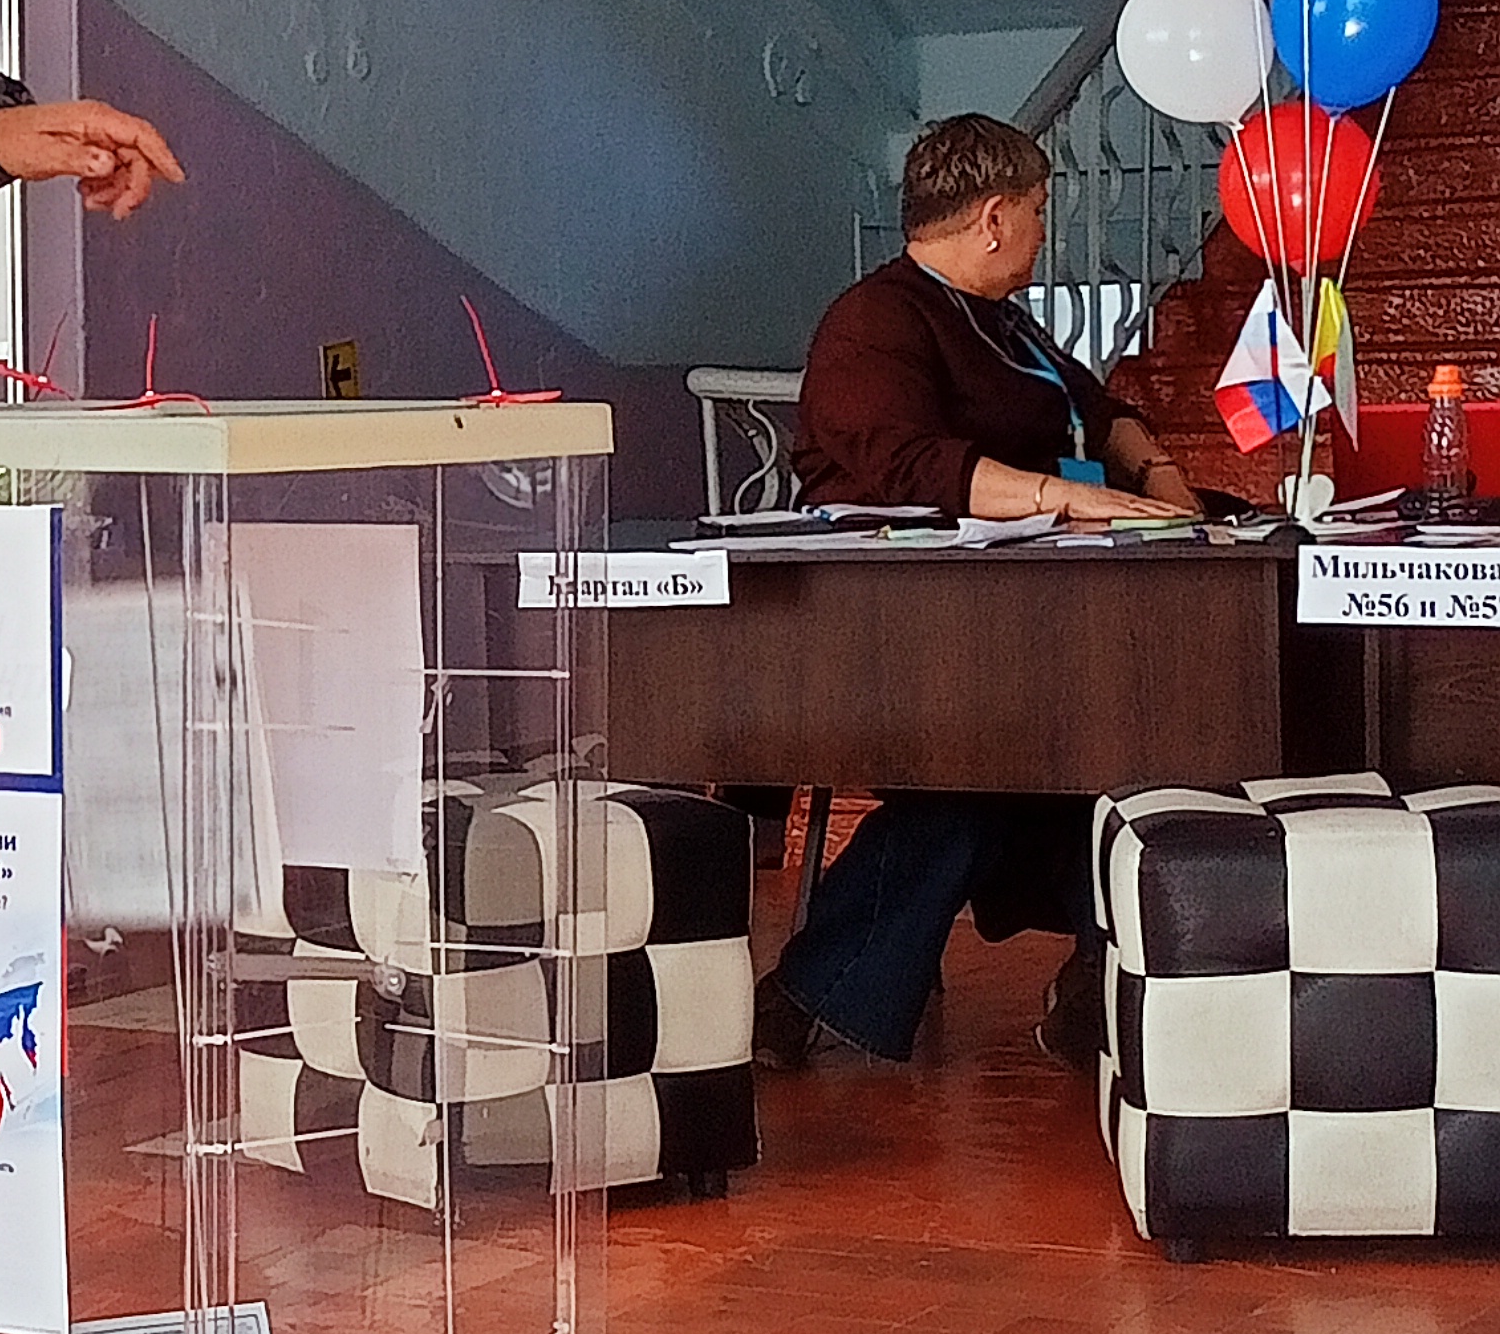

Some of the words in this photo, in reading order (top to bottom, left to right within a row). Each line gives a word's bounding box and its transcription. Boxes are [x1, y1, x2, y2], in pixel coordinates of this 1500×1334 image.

[1312, 554, 1500, 581] Мильчакова
[548, 574, 648, 602] артал
[657, 574, 703, 596] «Б»
[1342, 592, 1410, 618] №56
[1420, 600, 1436, 618] и
[1445, 594, 1500, 619] №5
